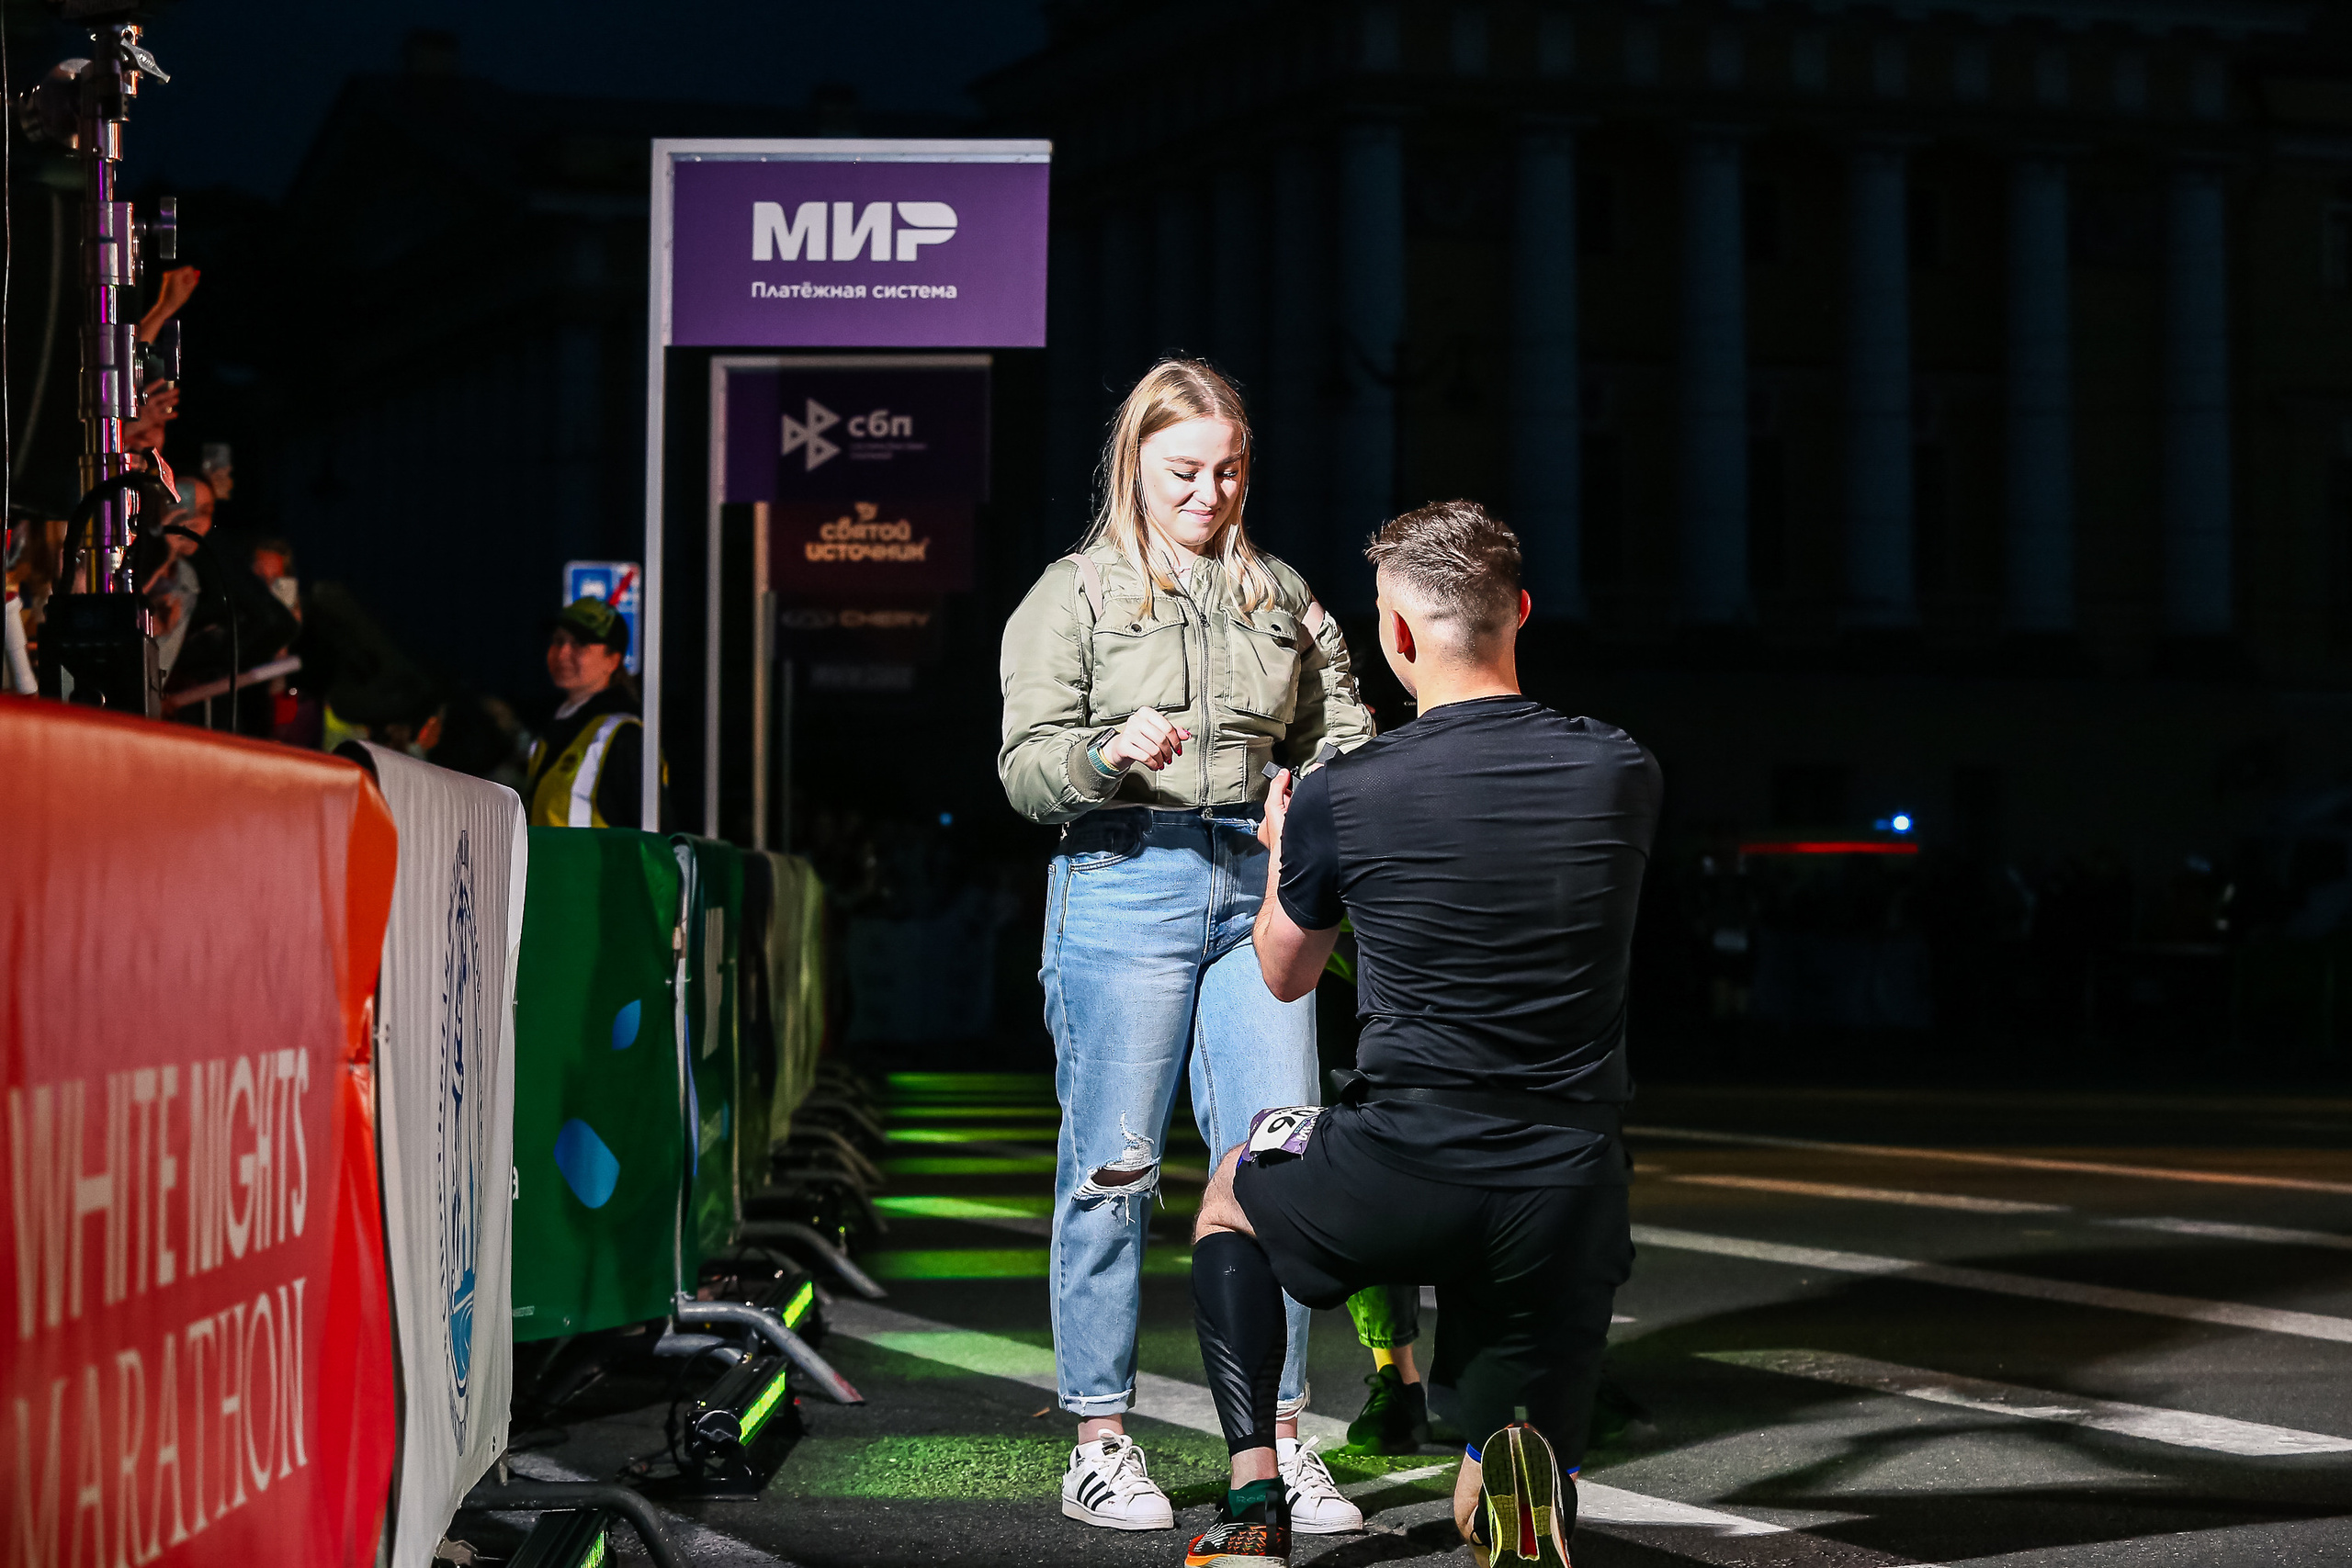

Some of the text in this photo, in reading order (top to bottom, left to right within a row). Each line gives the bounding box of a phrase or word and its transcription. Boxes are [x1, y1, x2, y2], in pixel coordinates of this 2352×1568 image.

[751, 281, 958, 299] Платёжная система
[752, 201, 958, 261] МИР
[8, 1064, 179, 1341] WHITE
[187, 1046, 309, 1276] NIGHTS
[13, 1277, 310, 1568] MARATHON
